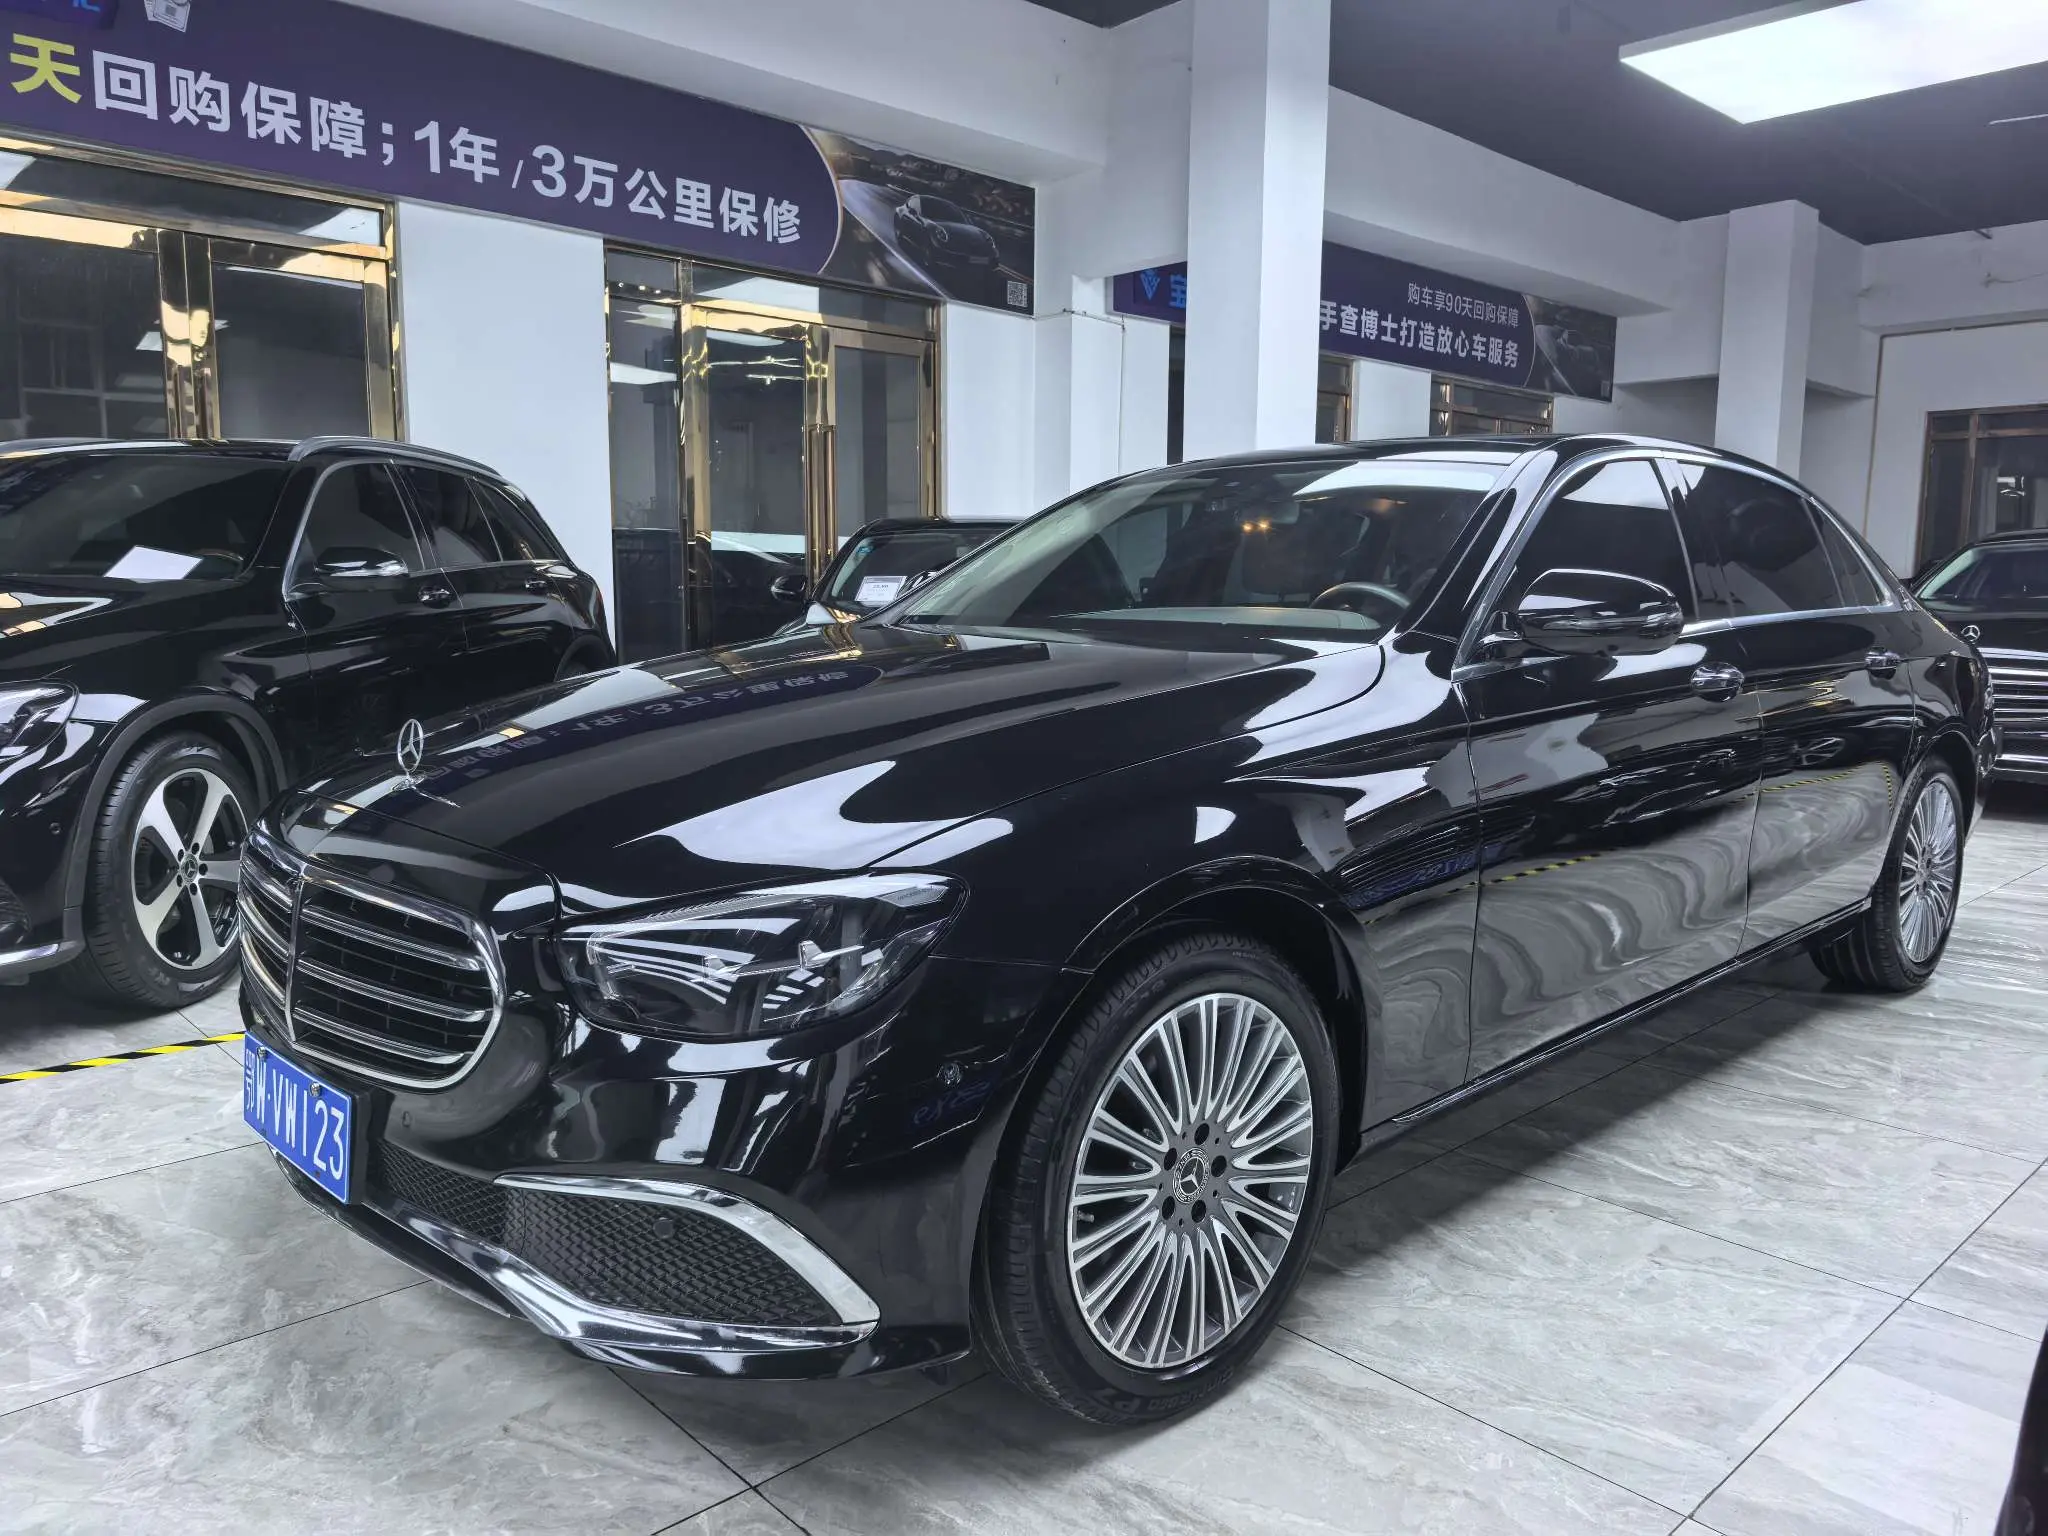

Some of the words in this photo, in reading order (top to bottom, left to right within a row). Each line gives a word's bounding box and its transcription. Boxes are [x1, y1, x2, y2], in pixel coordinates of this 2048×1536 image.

[1319, 299, 1519, 369] 手查博士打造放心车服务
[1407, 282, 1519, 329] 购车享90天回购保障
